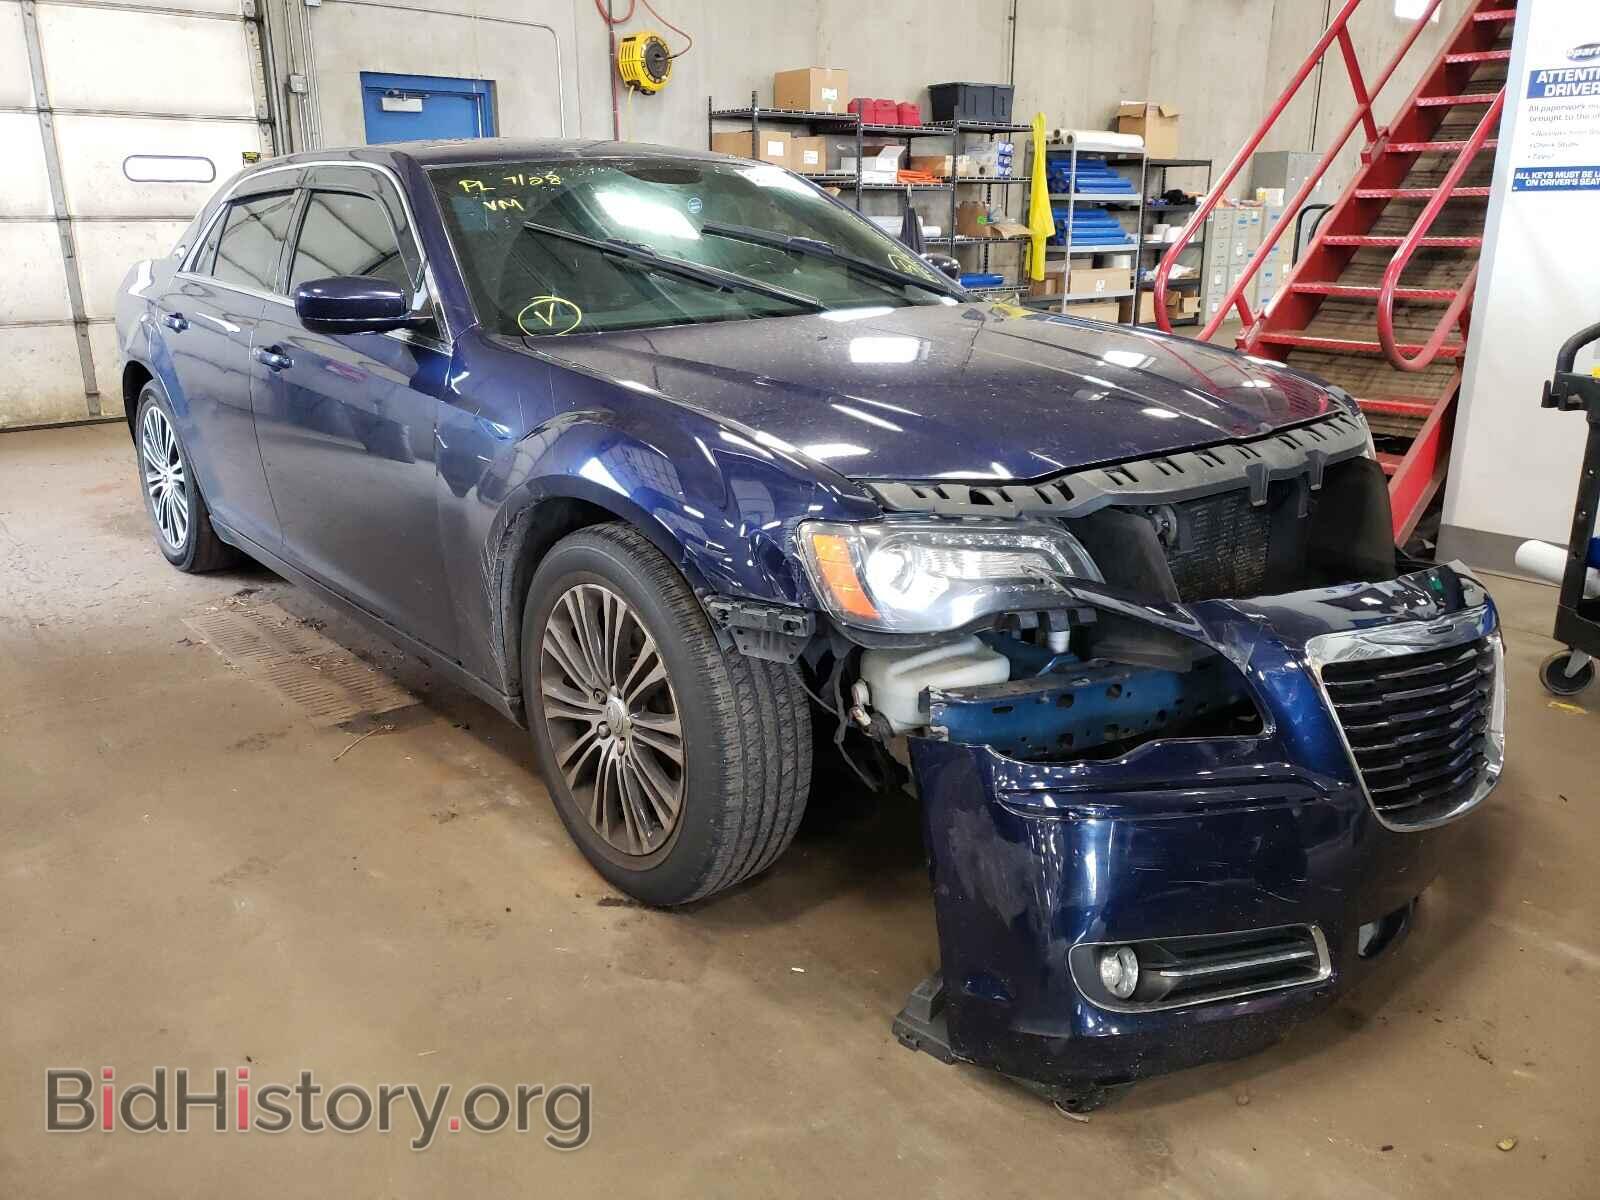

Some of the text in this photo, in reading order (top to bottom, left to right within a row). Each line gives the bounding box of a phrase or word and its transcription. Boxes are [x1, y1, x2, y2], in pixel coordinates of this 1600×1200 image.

[1515, 172, 1531, 180] ALL
[1532, 171, 1554, 179] KEYS
[1555, 171, 1580, 179] MUST
[1525, 179, 1539, 187] ON
[1540, 178, 1579, 186] DRIVER'S
